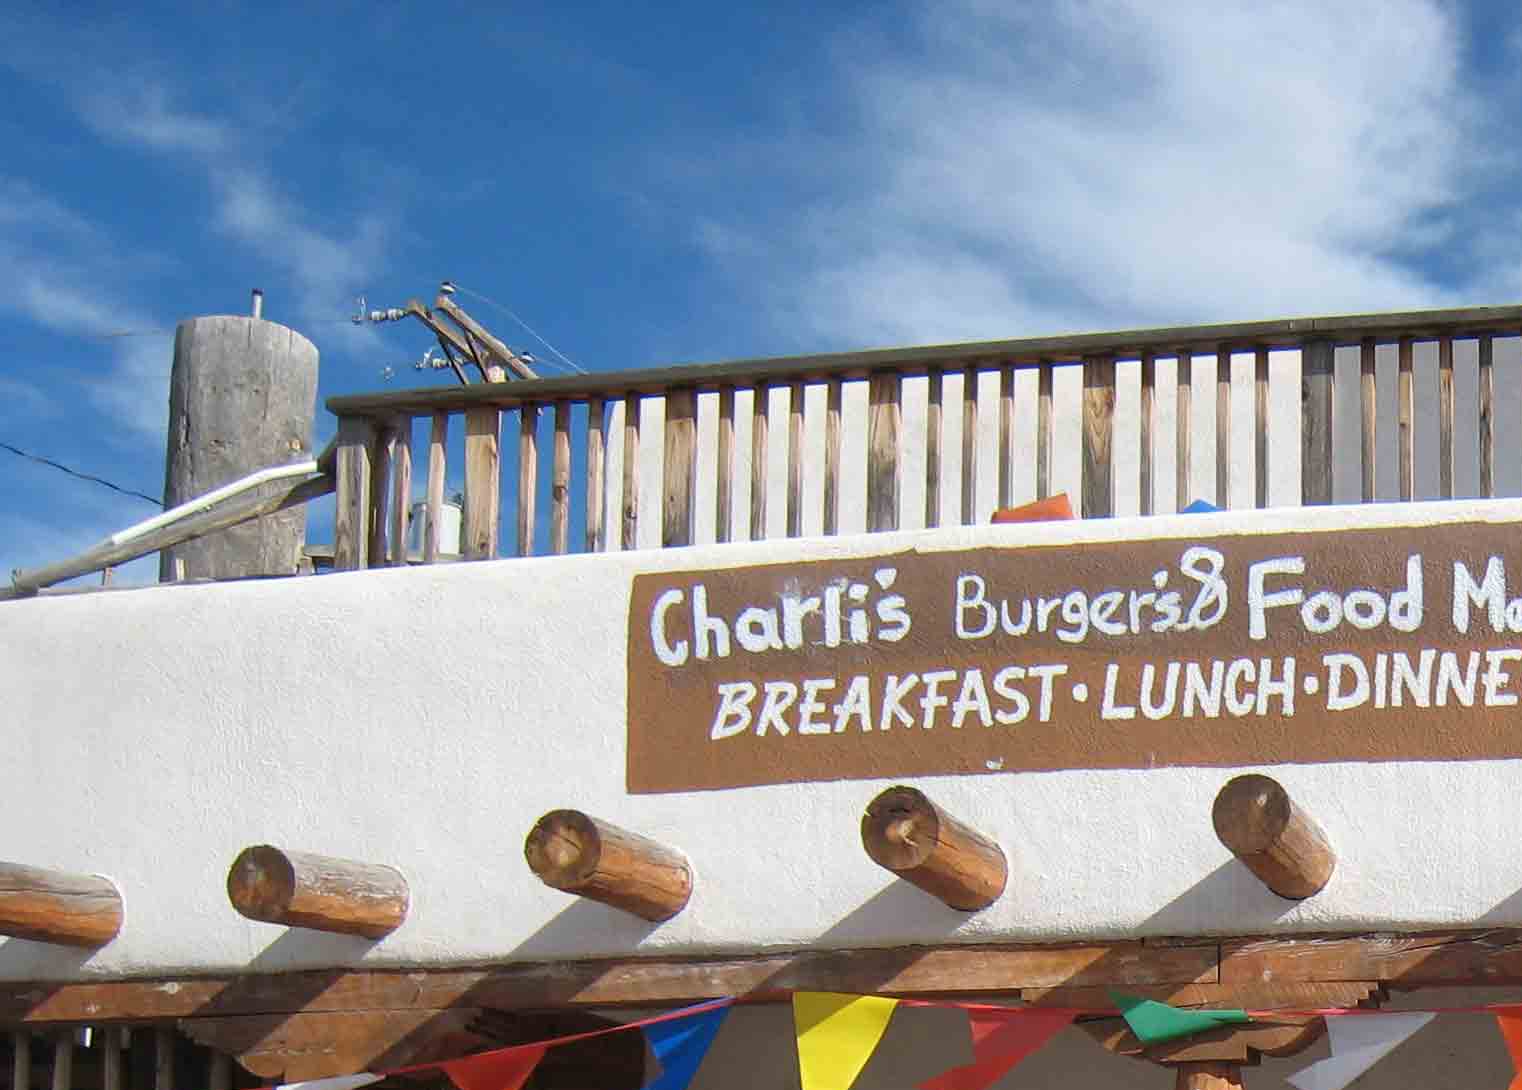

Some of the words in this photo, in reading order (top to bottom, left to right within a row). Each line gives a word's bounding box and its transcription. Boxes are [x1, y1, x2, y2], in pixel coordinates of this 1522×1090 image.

[1248, 553, 1423, 640] Food
[711, 663, 1068, 740] BREAKFAST
[1101, 656, 1296, 721] LUNCH
